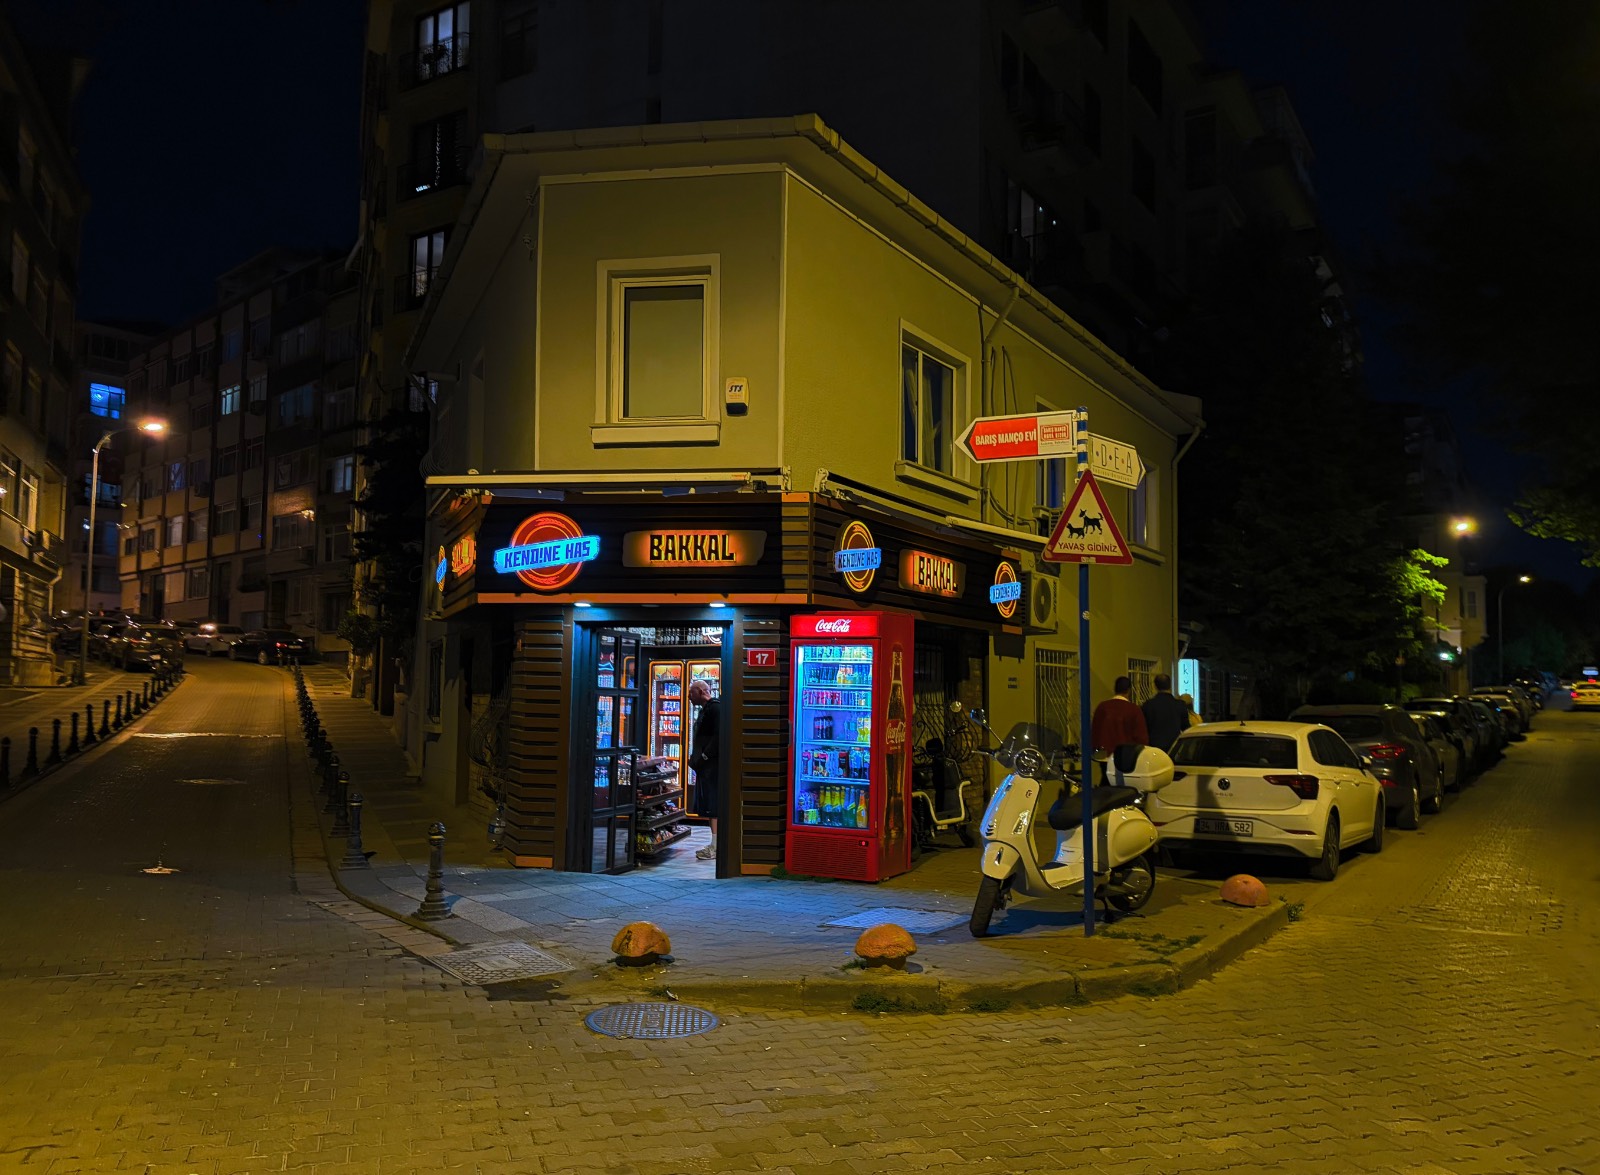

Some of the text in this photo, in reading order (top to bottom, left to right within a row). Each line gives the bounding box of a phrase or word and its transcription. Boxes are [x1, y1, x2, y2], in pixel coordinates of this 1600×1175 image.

[728, 384, 743, 393] STS
[975, 433, 997, 446] BARIŞ
[998, 431, 1024, 444] MANÇO
[1024, 428, 1037, 441] EVİ
[565, 541, 591, 560] HAS
[650, 534, 736, 562] BAKKAL
[1058, 541, 1118, 553] YAVAŞ GİDİNİZ
[866, 551, 878, 566] HAS
[815, 618, 852, 634] Coca-Cola
[755, 653, 769, 665] 17
[1234, 822, 1251, 833] 582
